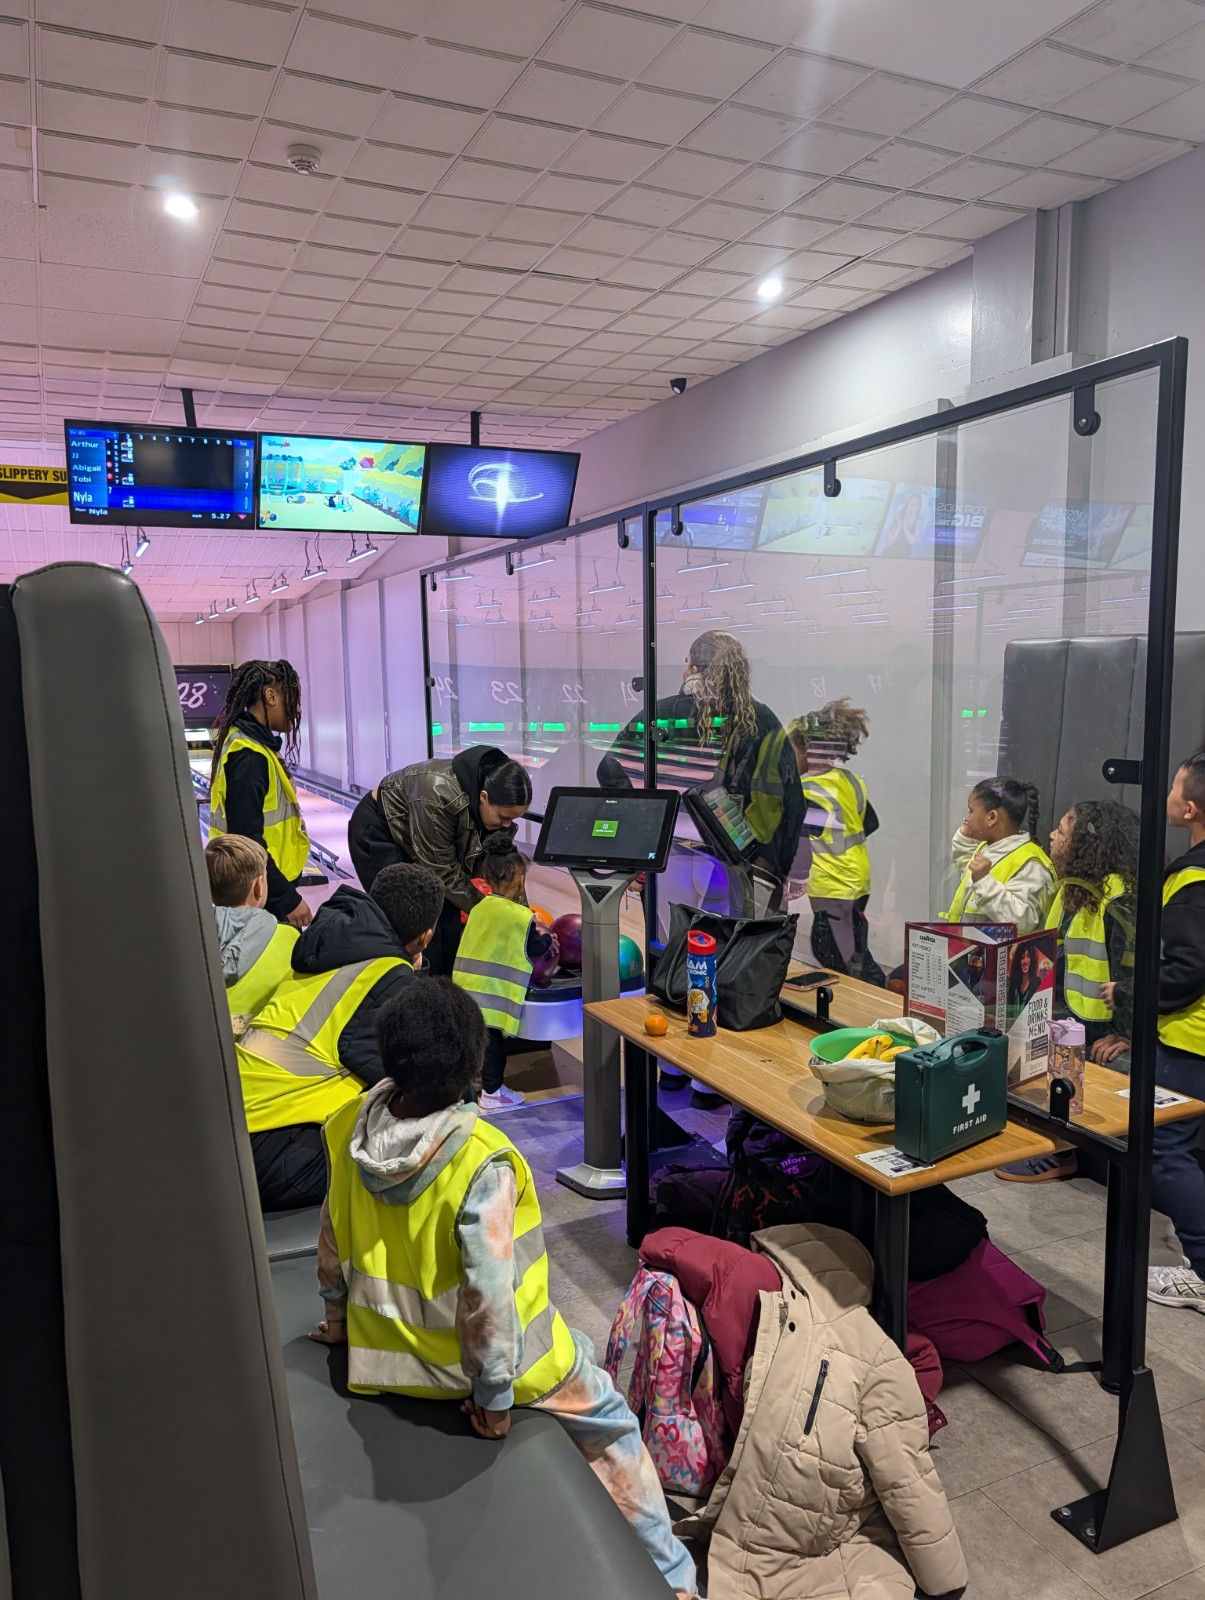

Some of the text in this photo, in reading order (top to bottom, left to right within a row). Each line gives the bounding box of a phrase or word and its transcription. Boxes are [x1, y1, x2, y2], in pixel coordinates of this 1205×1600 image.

[71, 440, 99, 448] Arthur
[245, 449, 250, 457] 8
[72, 464, 102, 472] Abigail
[245, 471, 249, 479] 8
[245, 460, 249, 468] 9
[245, 482, 249, 490] 7
[73, 491, 93, 504] Nyla
[88, 508, 108, 516] Nyla
[177, 682, 208, 709] 28
[1028, 998, 1043, 1015] FOOD
[1027, 1008, 1049, 1027] DRINKS
[1028, 1021, 1046, 1038] MENU
[952, 1113, 987, 1135] FIRST AID
